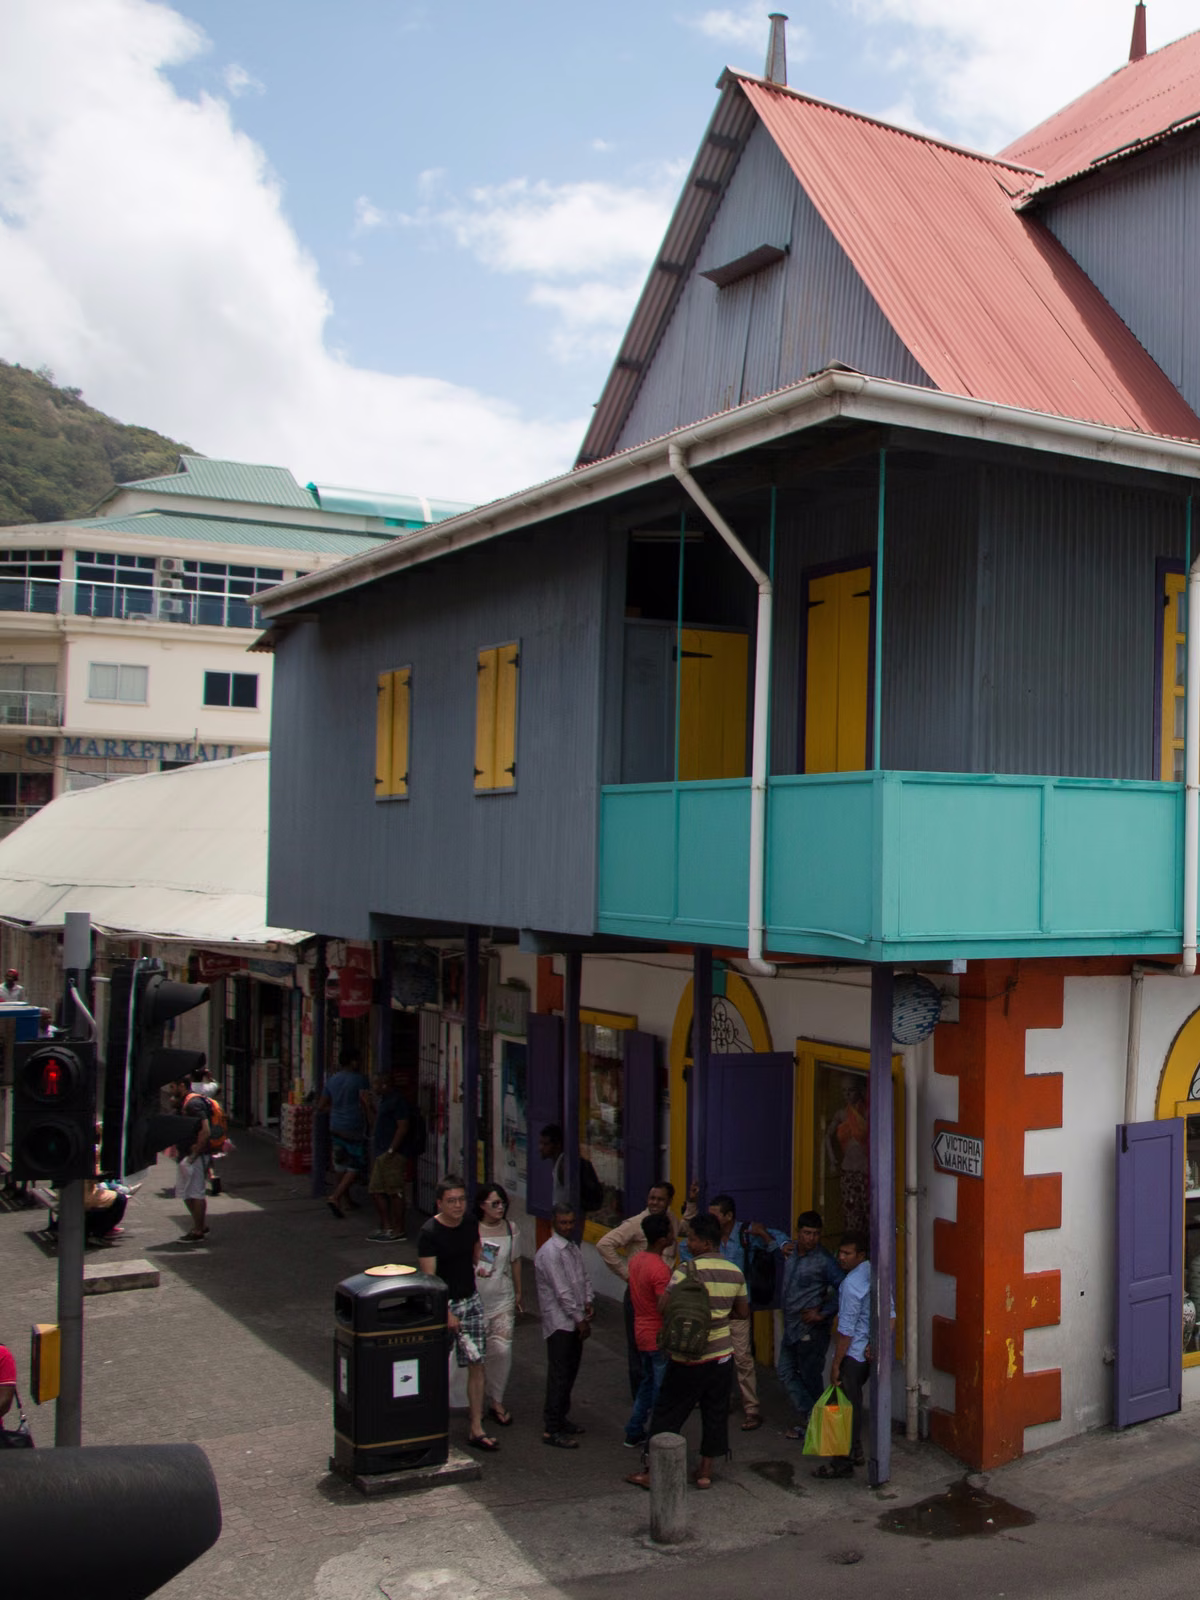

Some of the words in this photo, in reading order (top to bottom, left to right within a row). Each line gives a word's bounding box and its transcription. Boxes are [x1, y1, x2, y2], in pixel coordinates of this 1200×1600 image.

[64, 737, 171, 760] MARKET
[945, 1135, 980, 1158] VICTORIA
[944, 1152, 979, 1174] MARKET
[388, 1335, 425, 1344] LITTER
